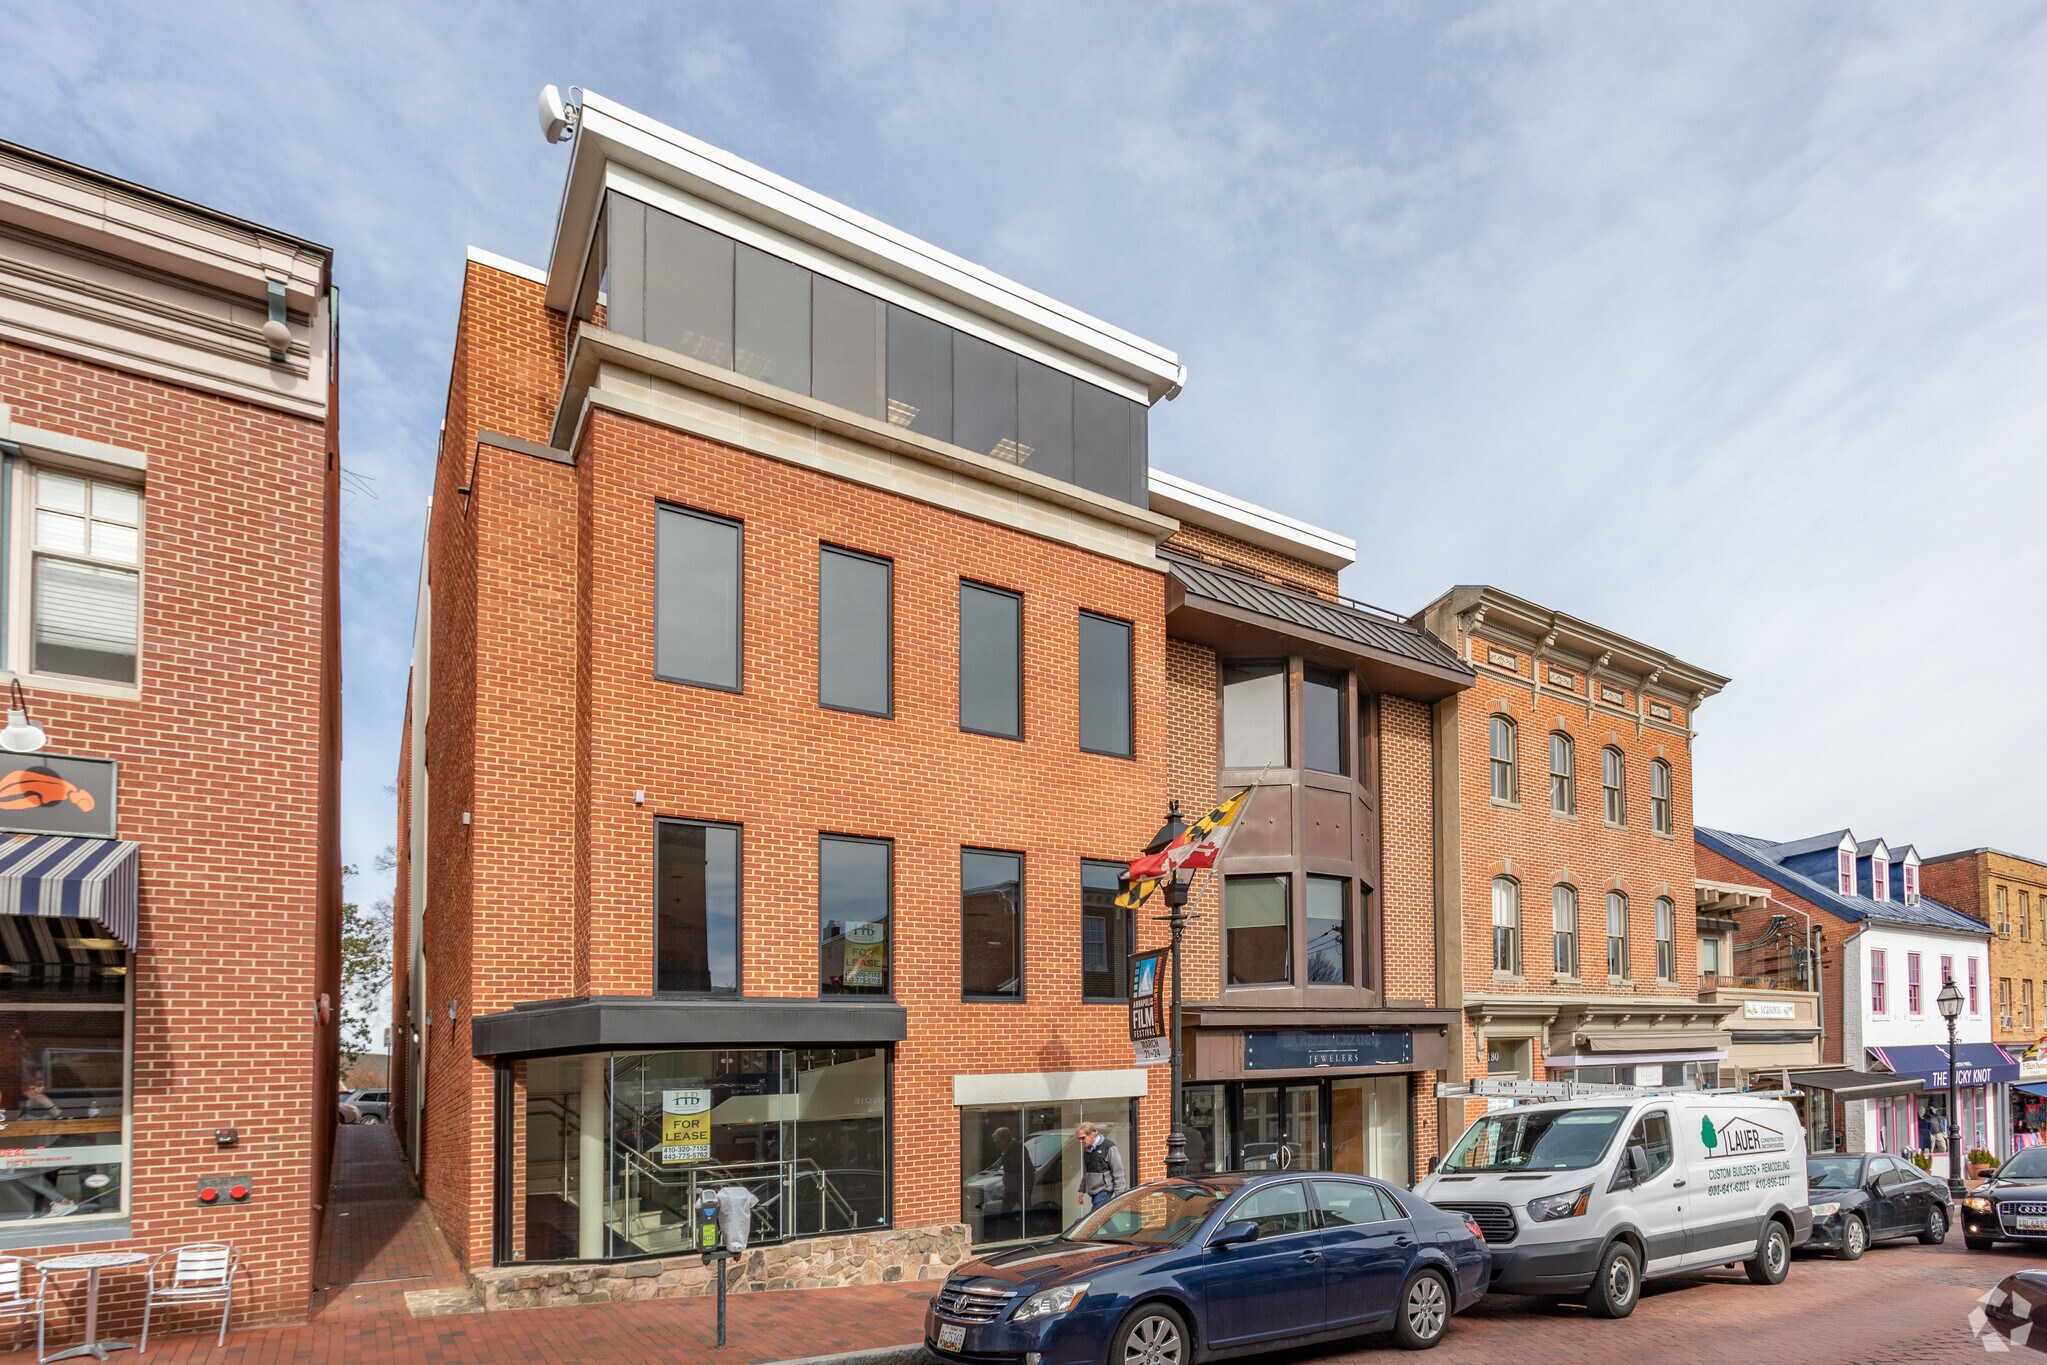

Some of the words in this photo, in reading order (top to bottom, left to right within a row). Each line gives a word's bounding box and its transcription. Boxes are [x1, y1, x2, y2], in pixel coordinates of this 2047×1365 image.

[852, 948, 874, 957] FOR
[845, 959, 881, 968] LEASE
[1133, 997, 1154, 1009] ANNAPOLIS
[1133, 1006, 1155, 1030] FILM
[1134, 1028, 1156, 1038] FESTIVAL
[1140, 1039, 1160, 1049] MARCH
[1308, 1053, 1359, 1064] JEWELERS
[1487, 1051, 1499, 1062] 180
[1933, 1071, 1948, 1087] THE
[1955, 1069, 1972, 1084] CKY
[1973, 1068, 1992, 1083] KNOT
[673, 1119, 700, 1129] FOR
[665, 1131, 708, 1142] LEASE
[1727, 1129, 1761, 1152] LAUER
[663, 1145, 708, 1153] 410-320-7152
[1708, 1168, 1732, 1181] CUSTOM
[1733, 1164, 1757, 1177] BUILDERS
[1761, 1160, 1790, 1173] REMODELING
[1707, 1180, 1750, 1197] 800-841-6203
